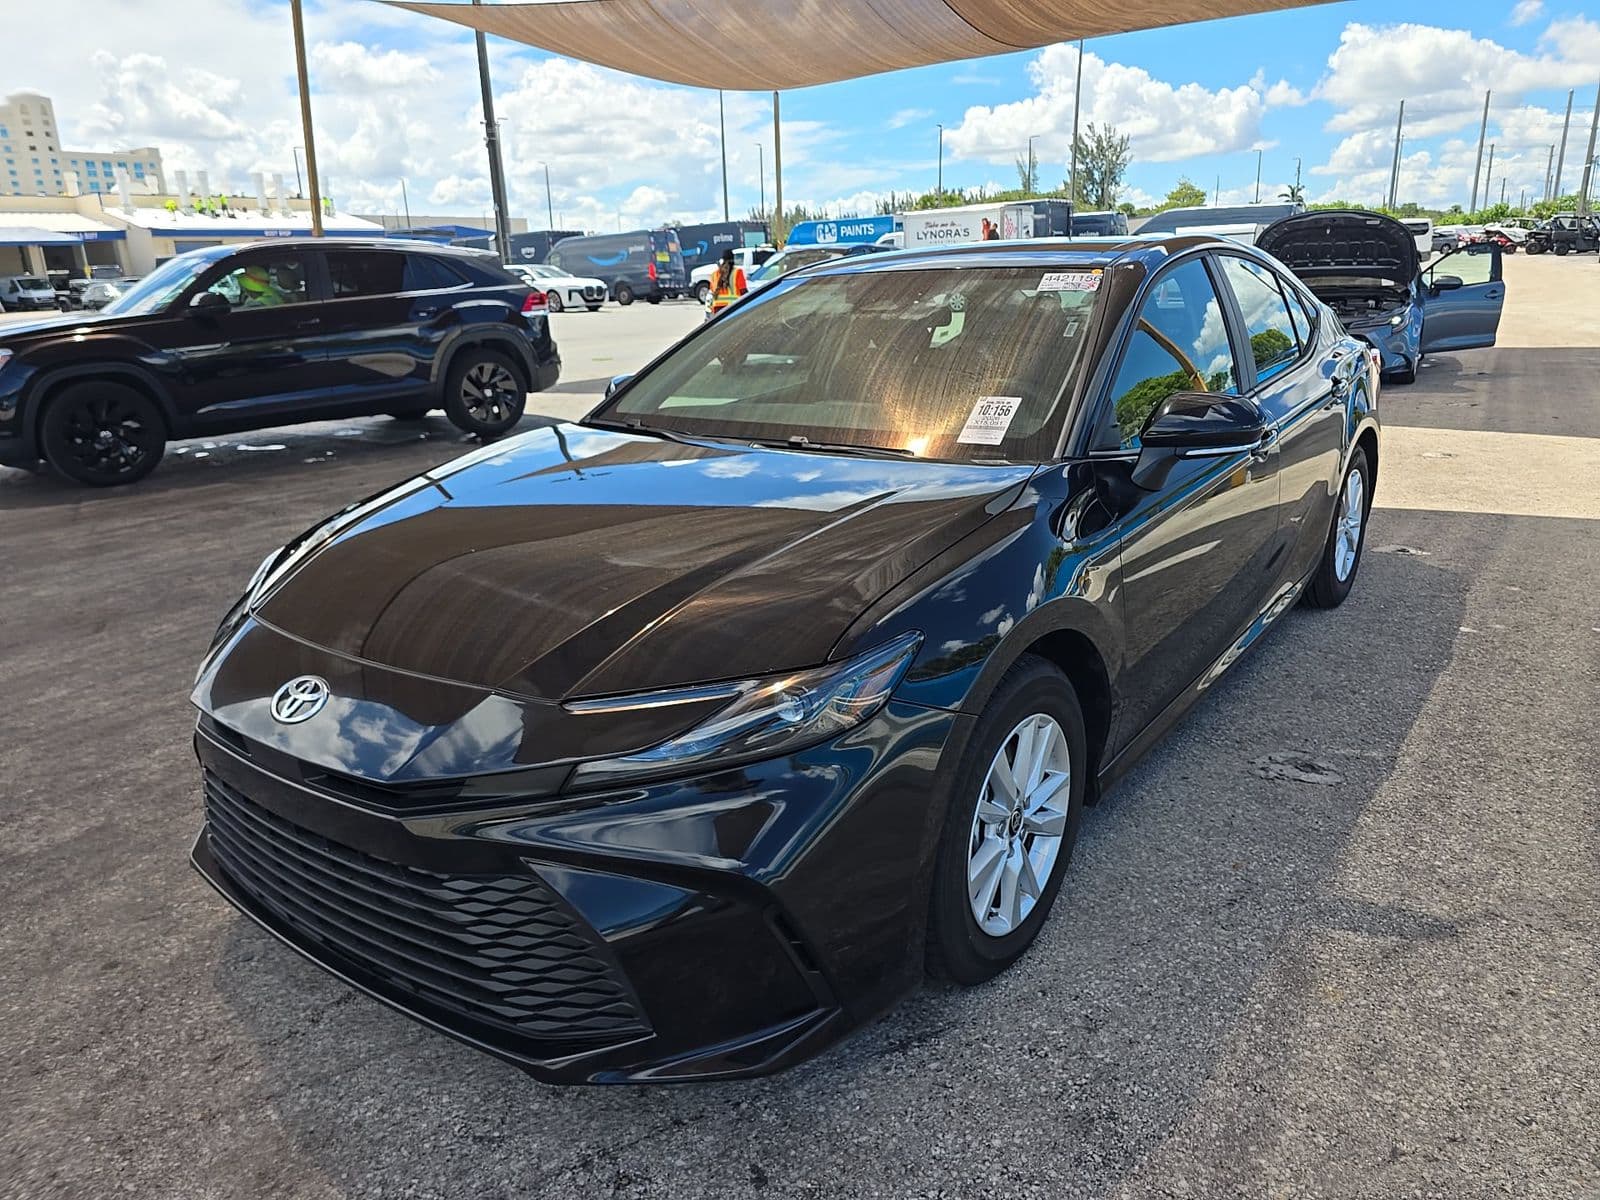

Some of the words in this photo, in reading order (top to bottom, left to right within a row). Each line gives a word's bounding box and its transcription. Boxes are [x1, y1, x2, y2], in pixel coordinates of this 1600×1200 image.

[840, 223, 875, 237] PAINTS
[916, 227, 970, 241] LYNORA'S
[713, 233, 733, 244] prime
[978, 404, 1013, 416] 10:156
